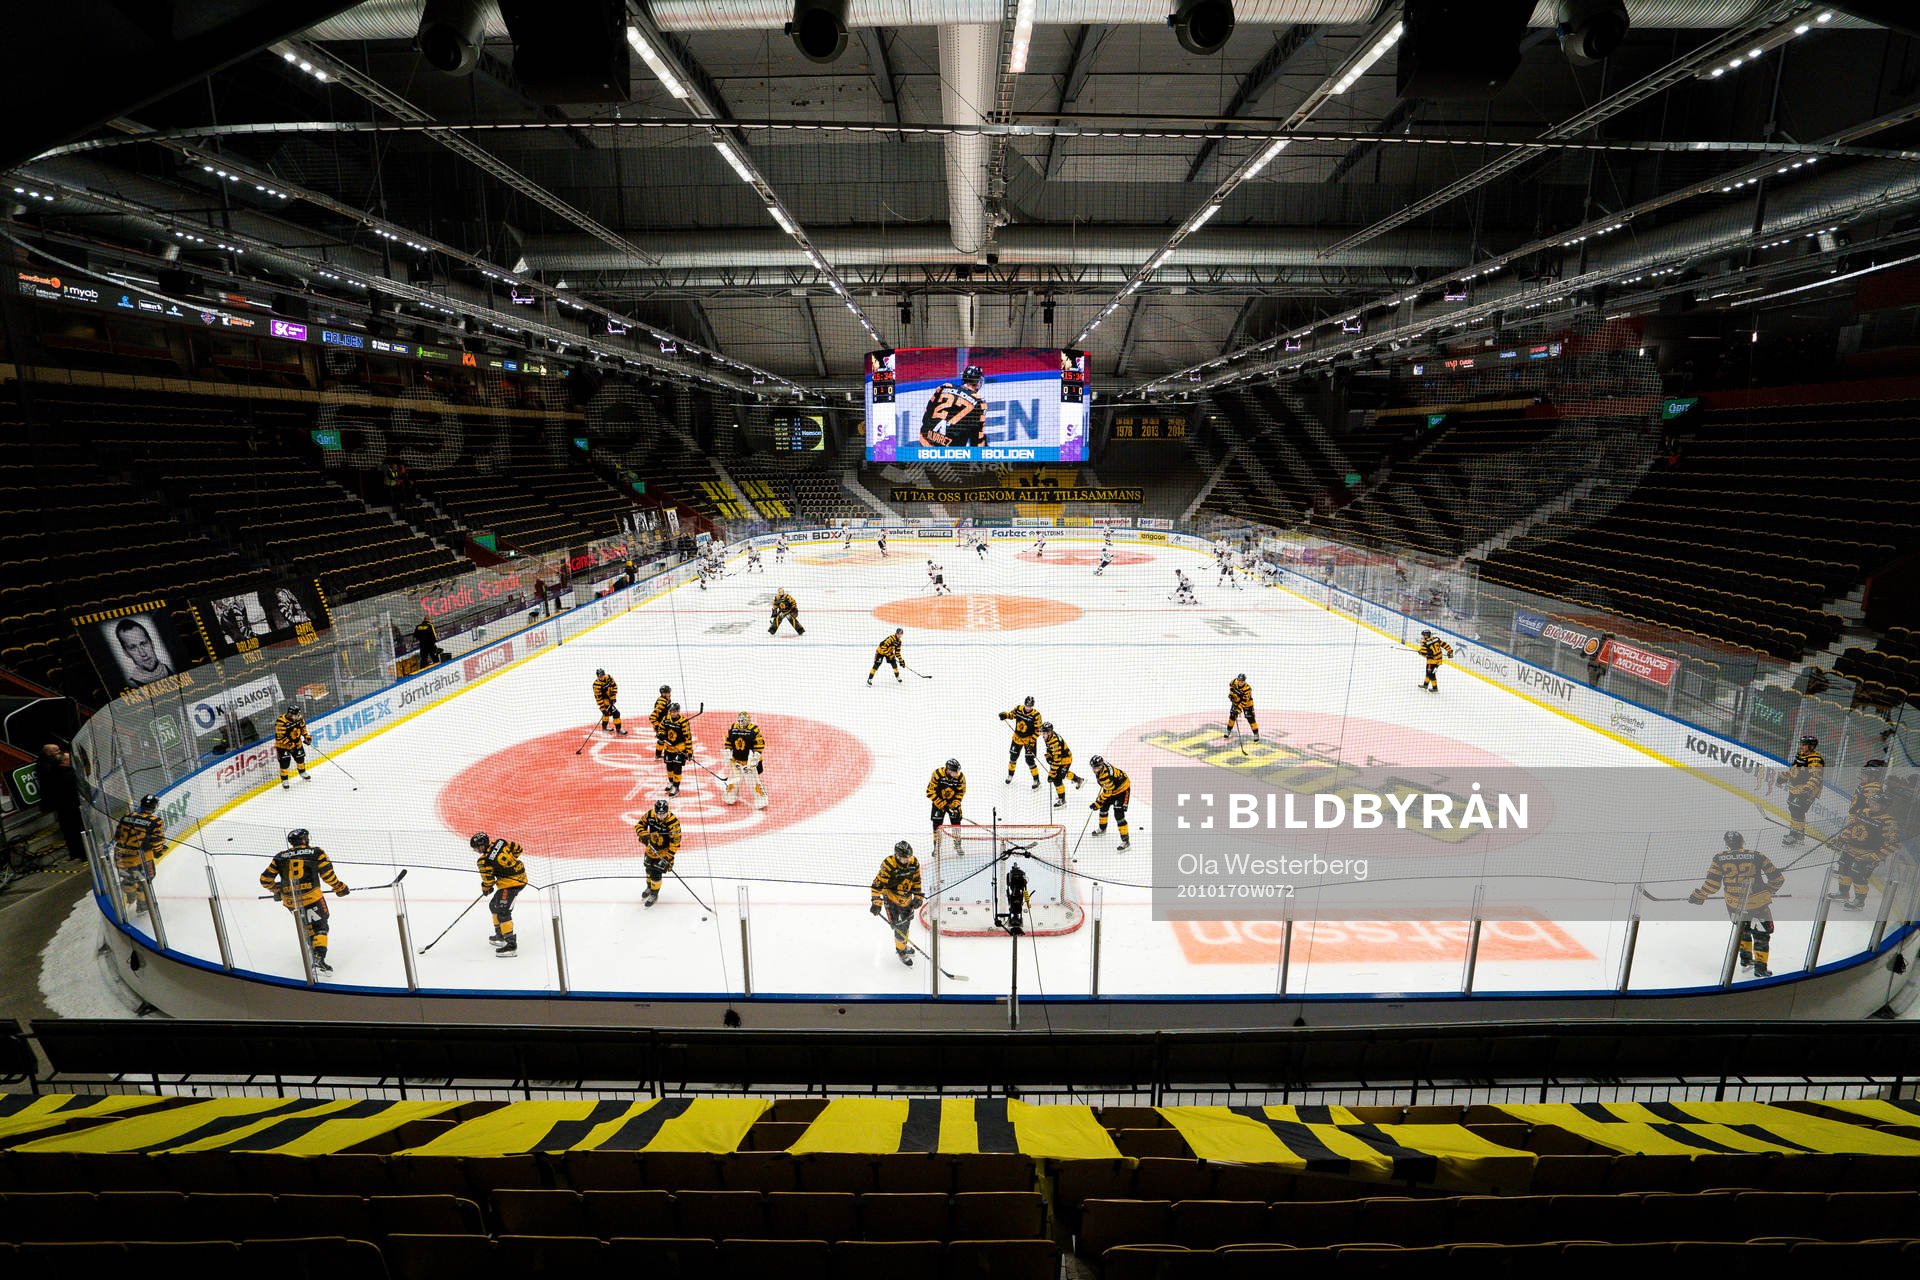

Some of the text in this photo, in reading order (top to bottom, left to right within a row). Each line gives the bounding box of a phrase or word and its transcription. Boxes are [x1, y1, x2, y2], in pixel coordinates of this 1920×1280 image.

[69, 286, 99, 299] myab
[932, 393, 975, 426] 27
[1116, 425, 1133, 437] 1978
[1142, 425, 1159, 437] 2013
[1168, 425, 1185, 437] 2014
[921, 449, 1035, 459] BOLIDEN BOLIDEN
[894, 490, 1141, 502] VI TAR OSS IGENOM ALLT TILLSAMMANS
[477, 572, 523, 599] Scandic
[421, 585, 474, 616] Scandic
[1469, 653, 1508, 677] KAIDING
[1611, 644, 1668, 670] NORDLUNDS
[1616, 658, 1652, 675] MOTOR
[311, 698, 394, 747] FUMEX
[288, 859, 304, 880] 8
[1722, 863, 1755, 884] 22
[1188, 911, 1566, 951] betsson
